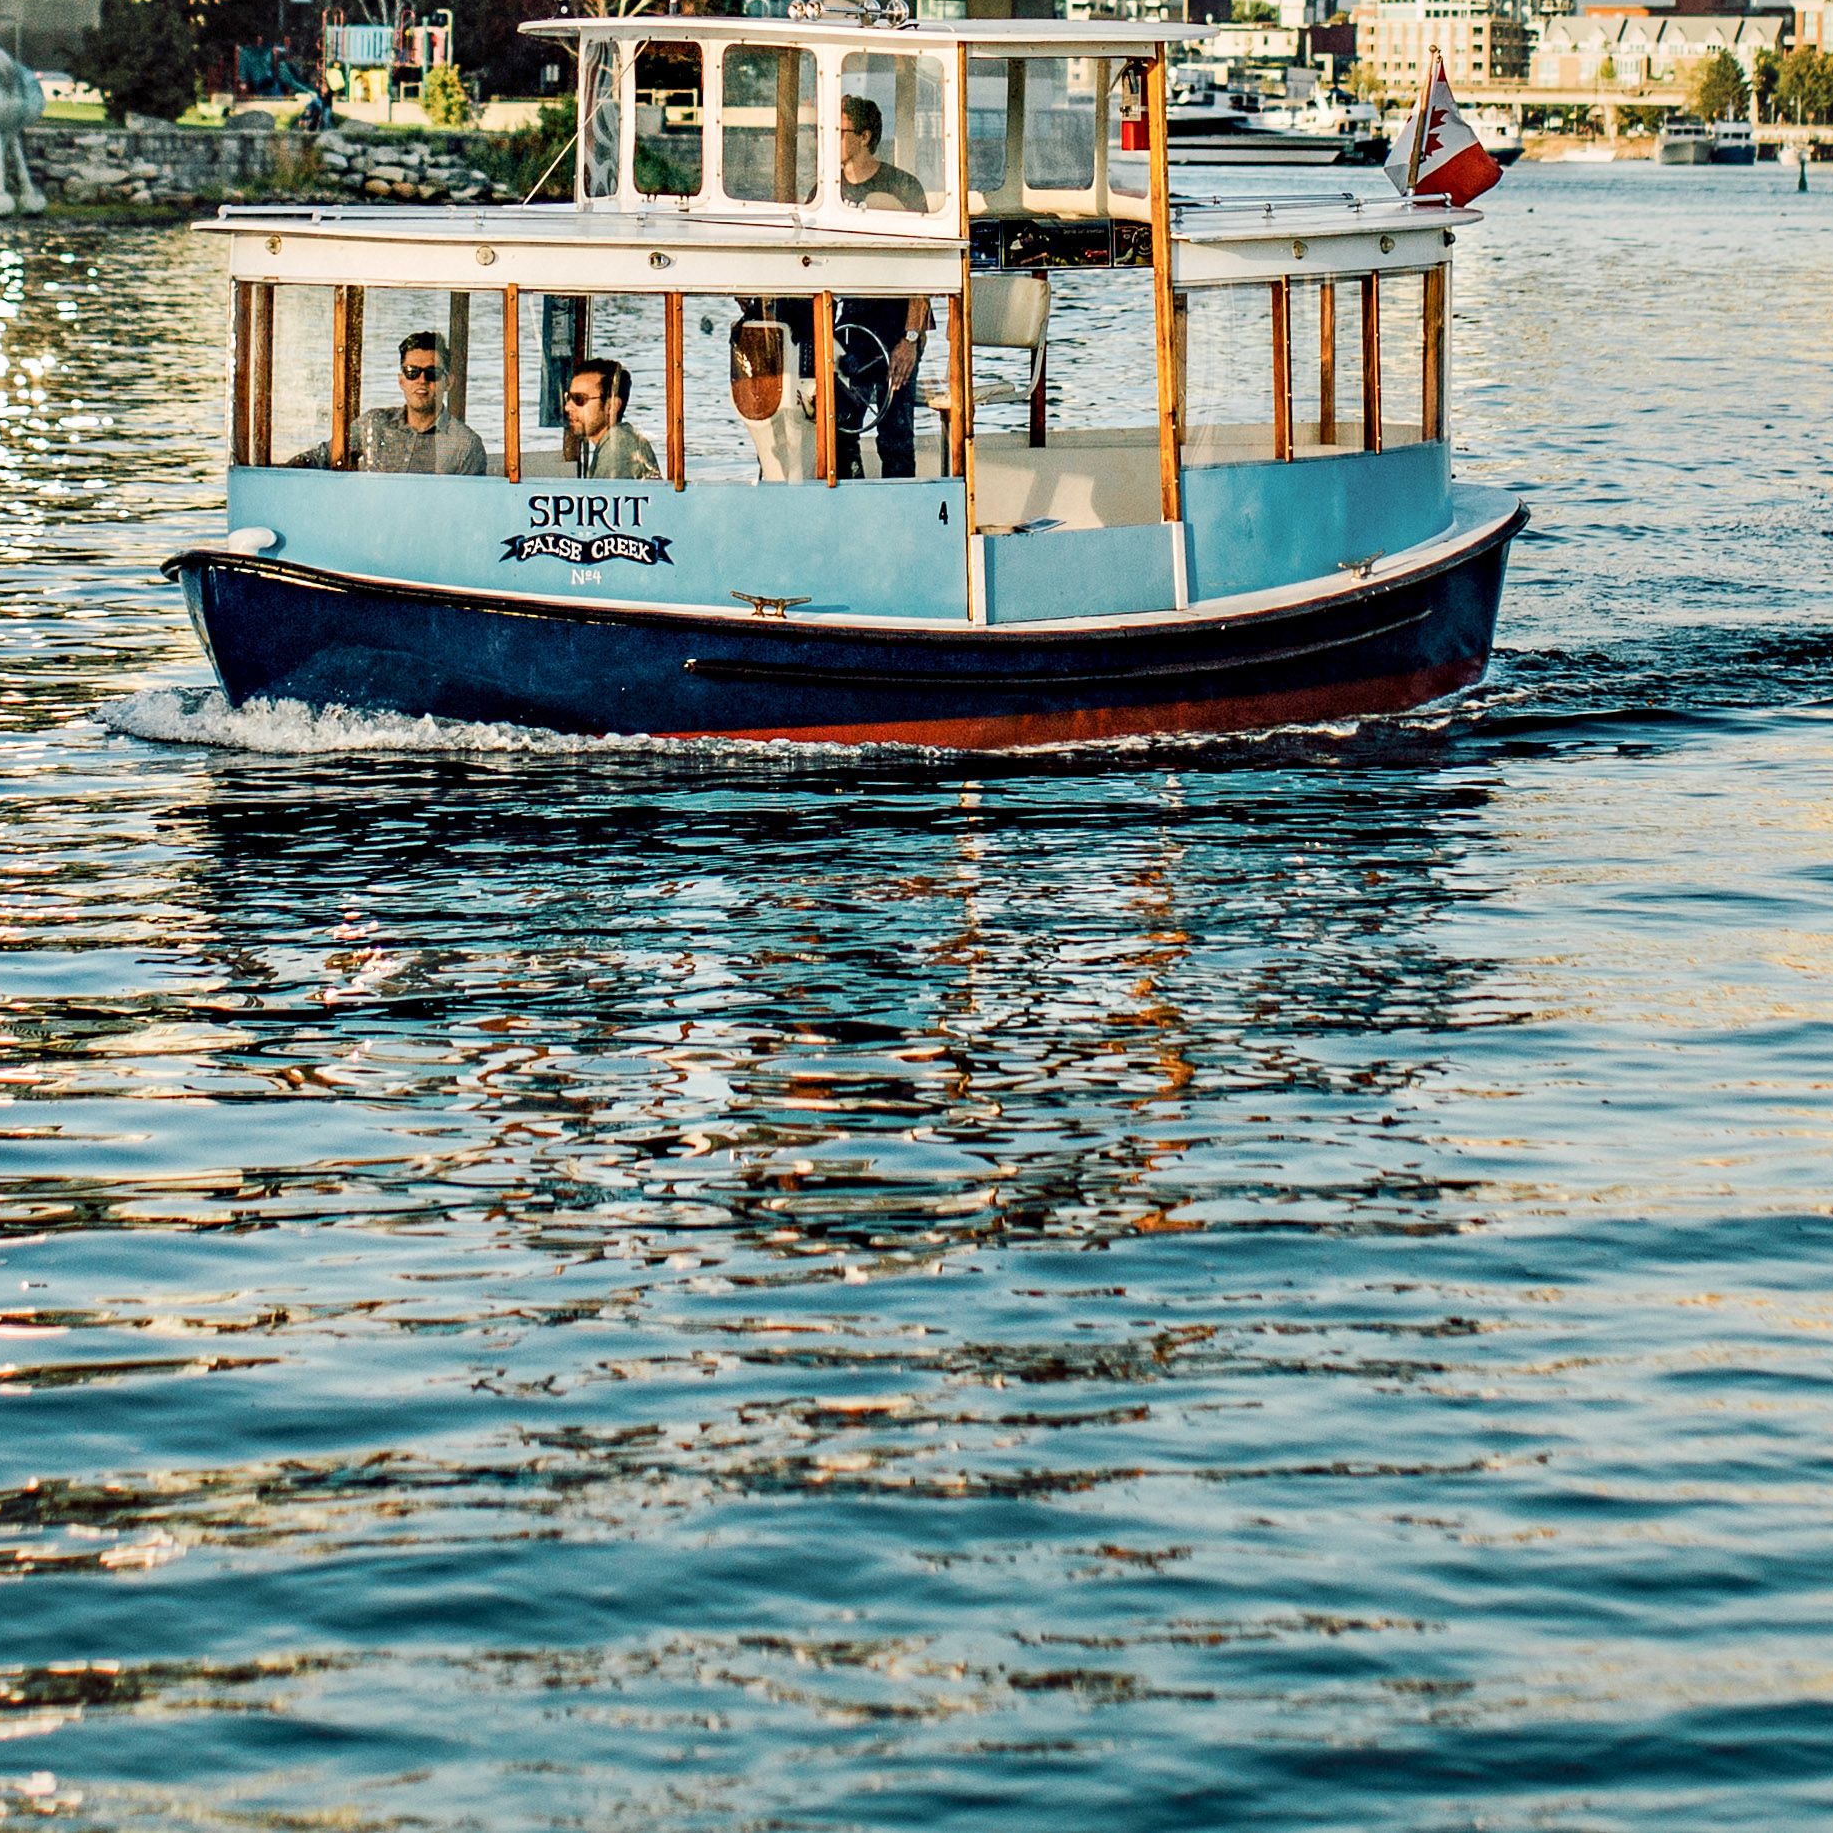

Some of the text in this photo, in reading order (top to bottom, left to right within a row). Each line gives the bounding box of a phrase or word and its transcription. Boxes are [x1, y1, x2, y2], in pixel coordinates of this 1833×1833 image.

[528, 495, 650, 532] SPIRIT
[938, 500, 949, 525] 4
[520, 536, 653, 563] FALSE CREEK
